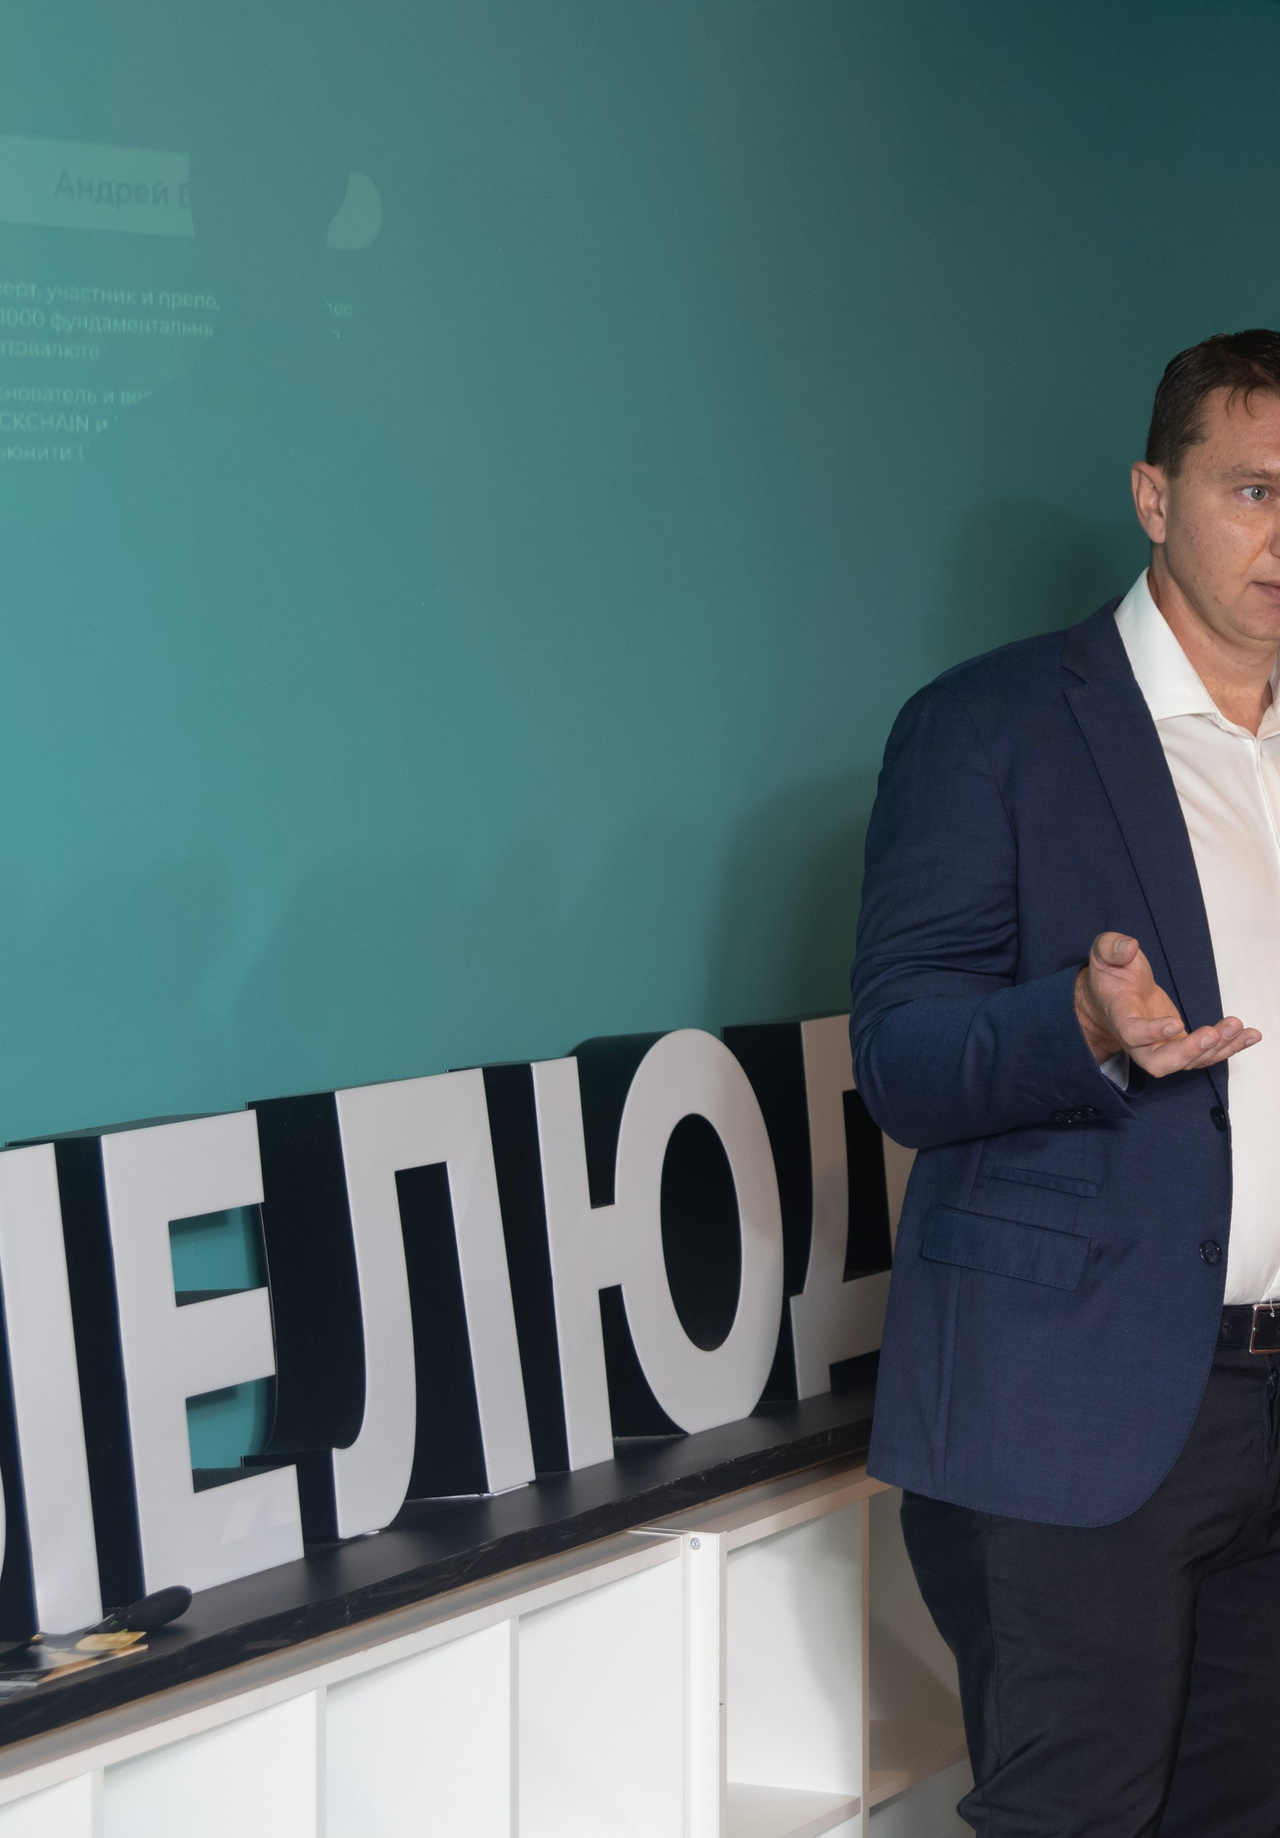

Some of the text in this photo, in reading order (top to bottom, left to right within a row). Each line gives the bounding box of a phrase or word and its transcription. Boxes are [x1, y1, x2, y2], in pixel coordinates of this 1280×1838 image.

[54, 169, 168, 210] Андрей
[0, 281, 221, 312] ерт, участник и препо
